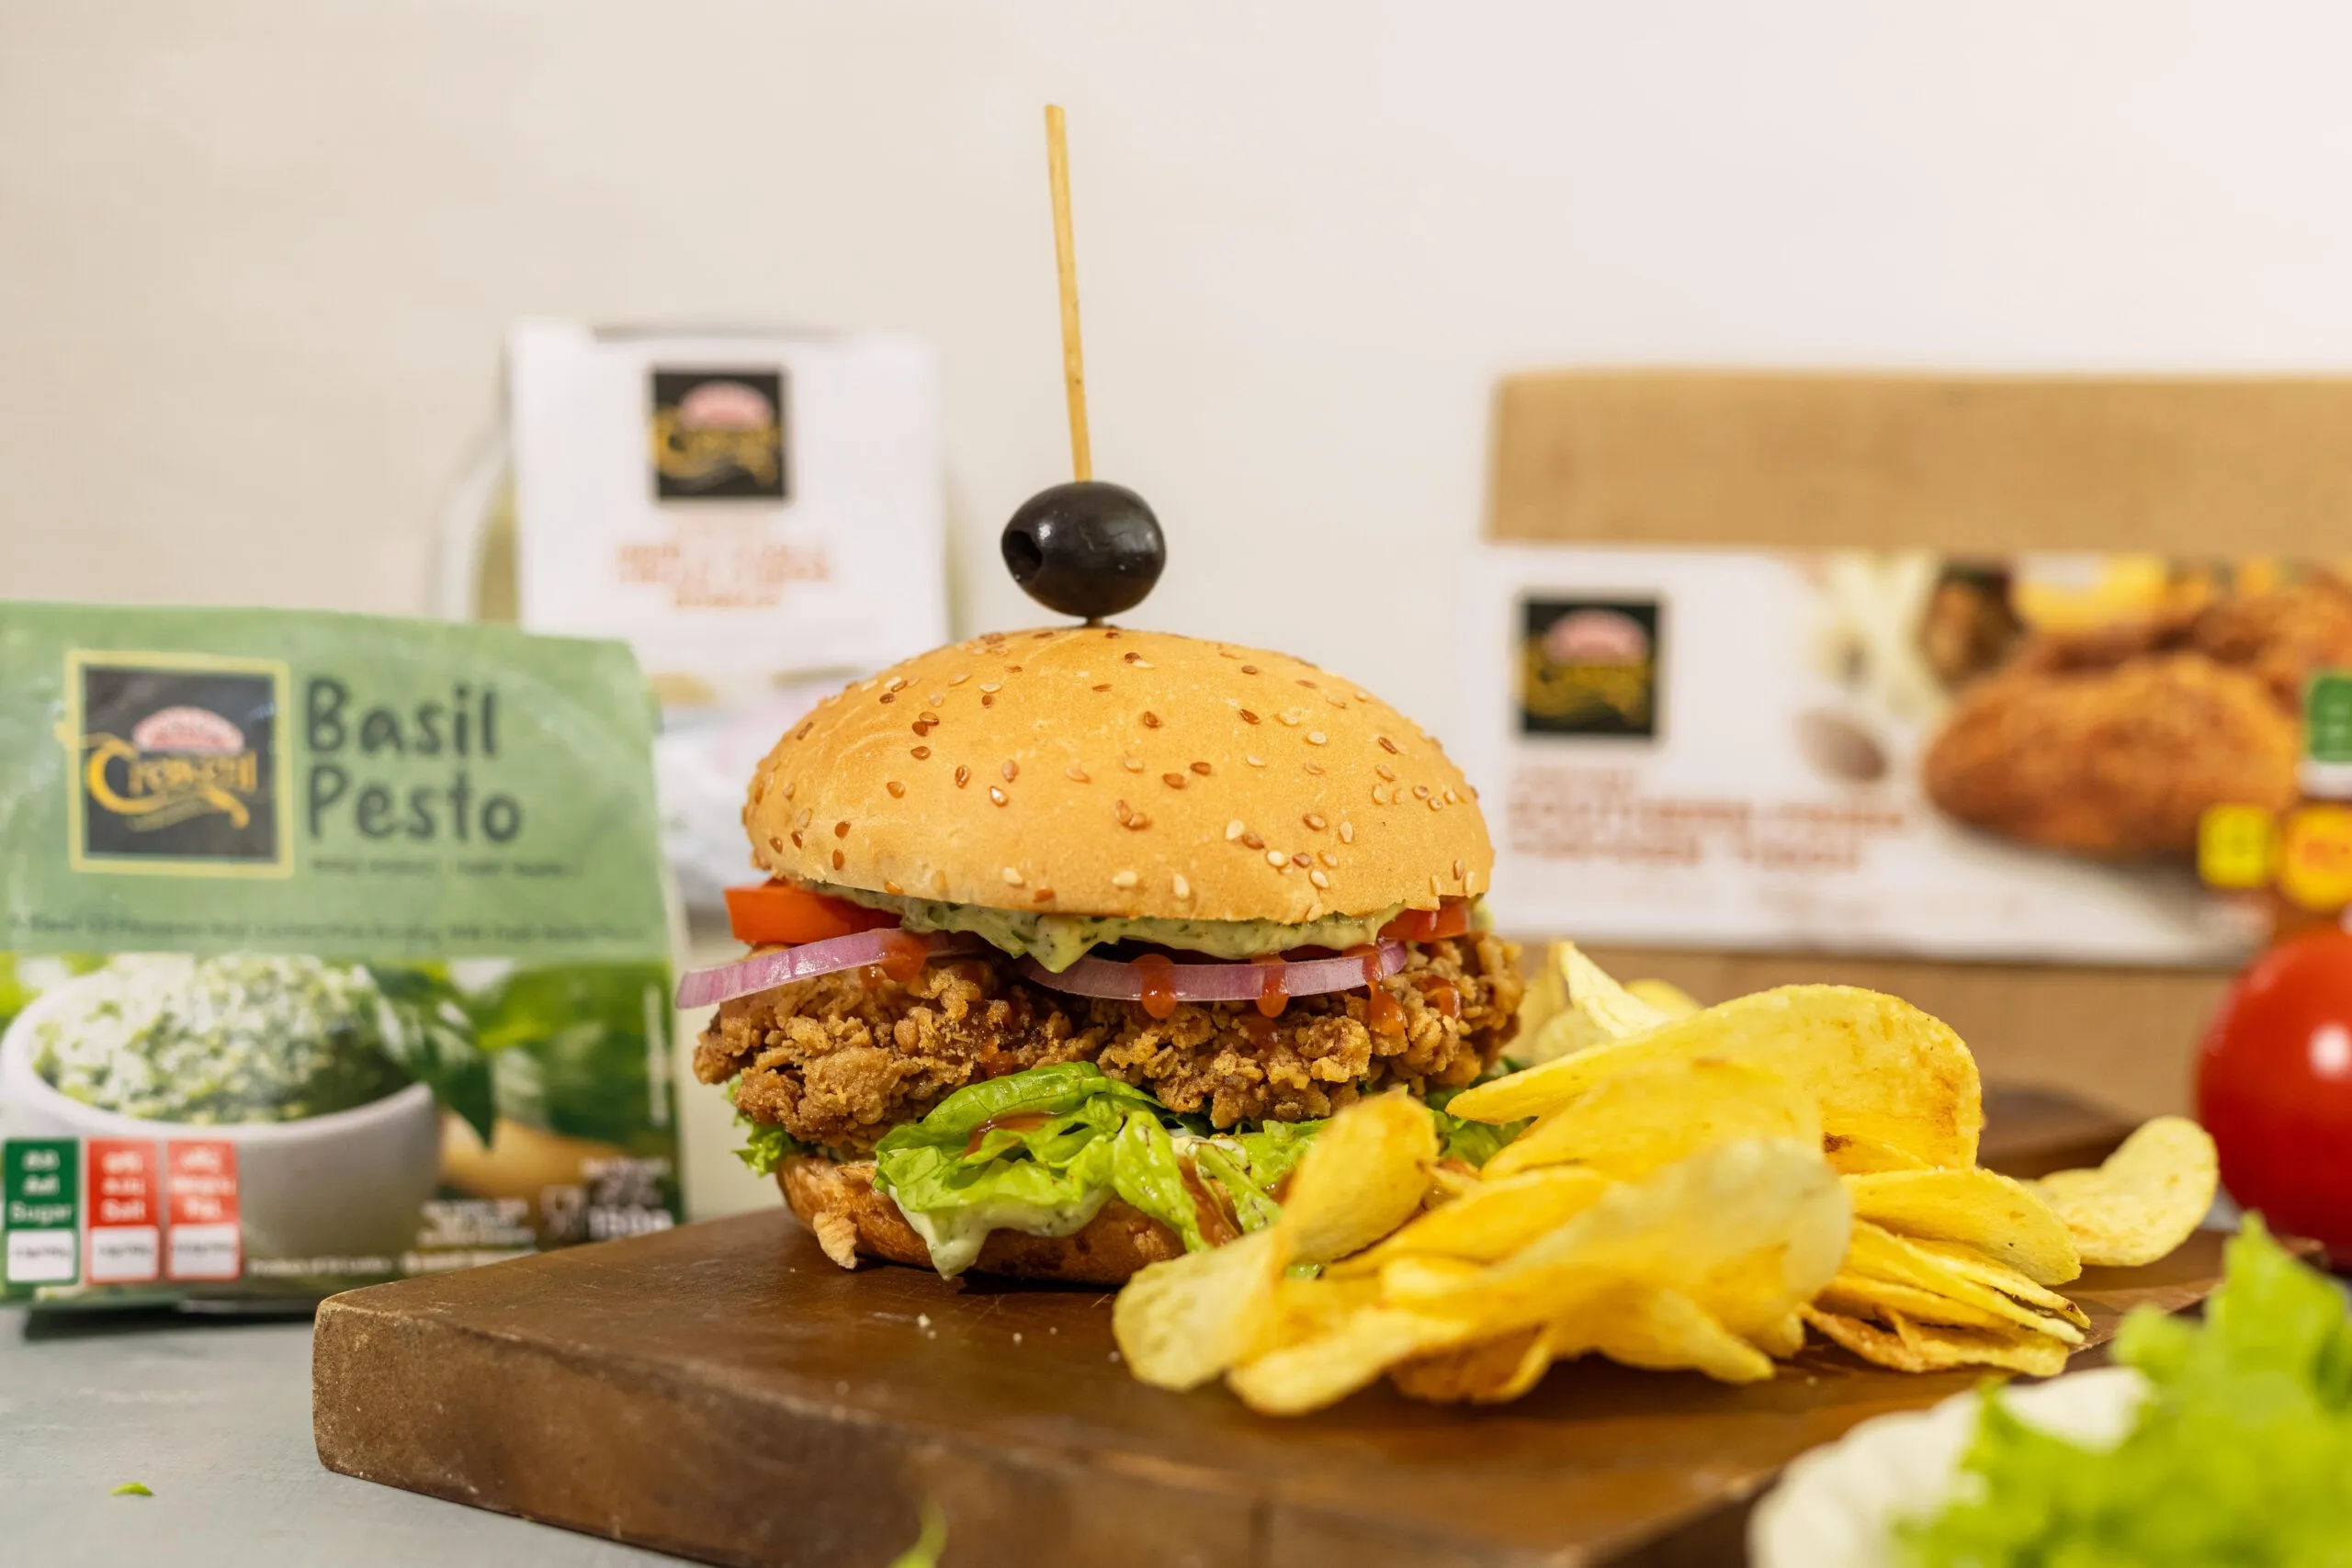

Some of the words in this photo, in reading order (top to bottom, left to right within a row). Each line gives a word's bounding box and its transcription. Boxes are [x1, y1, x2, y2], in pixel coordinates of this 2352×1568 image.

[308, 677, 500, 758] Basil
[308, 764, 522, 842] Pesto
[10, 1201, 72, 1224] Sugar
